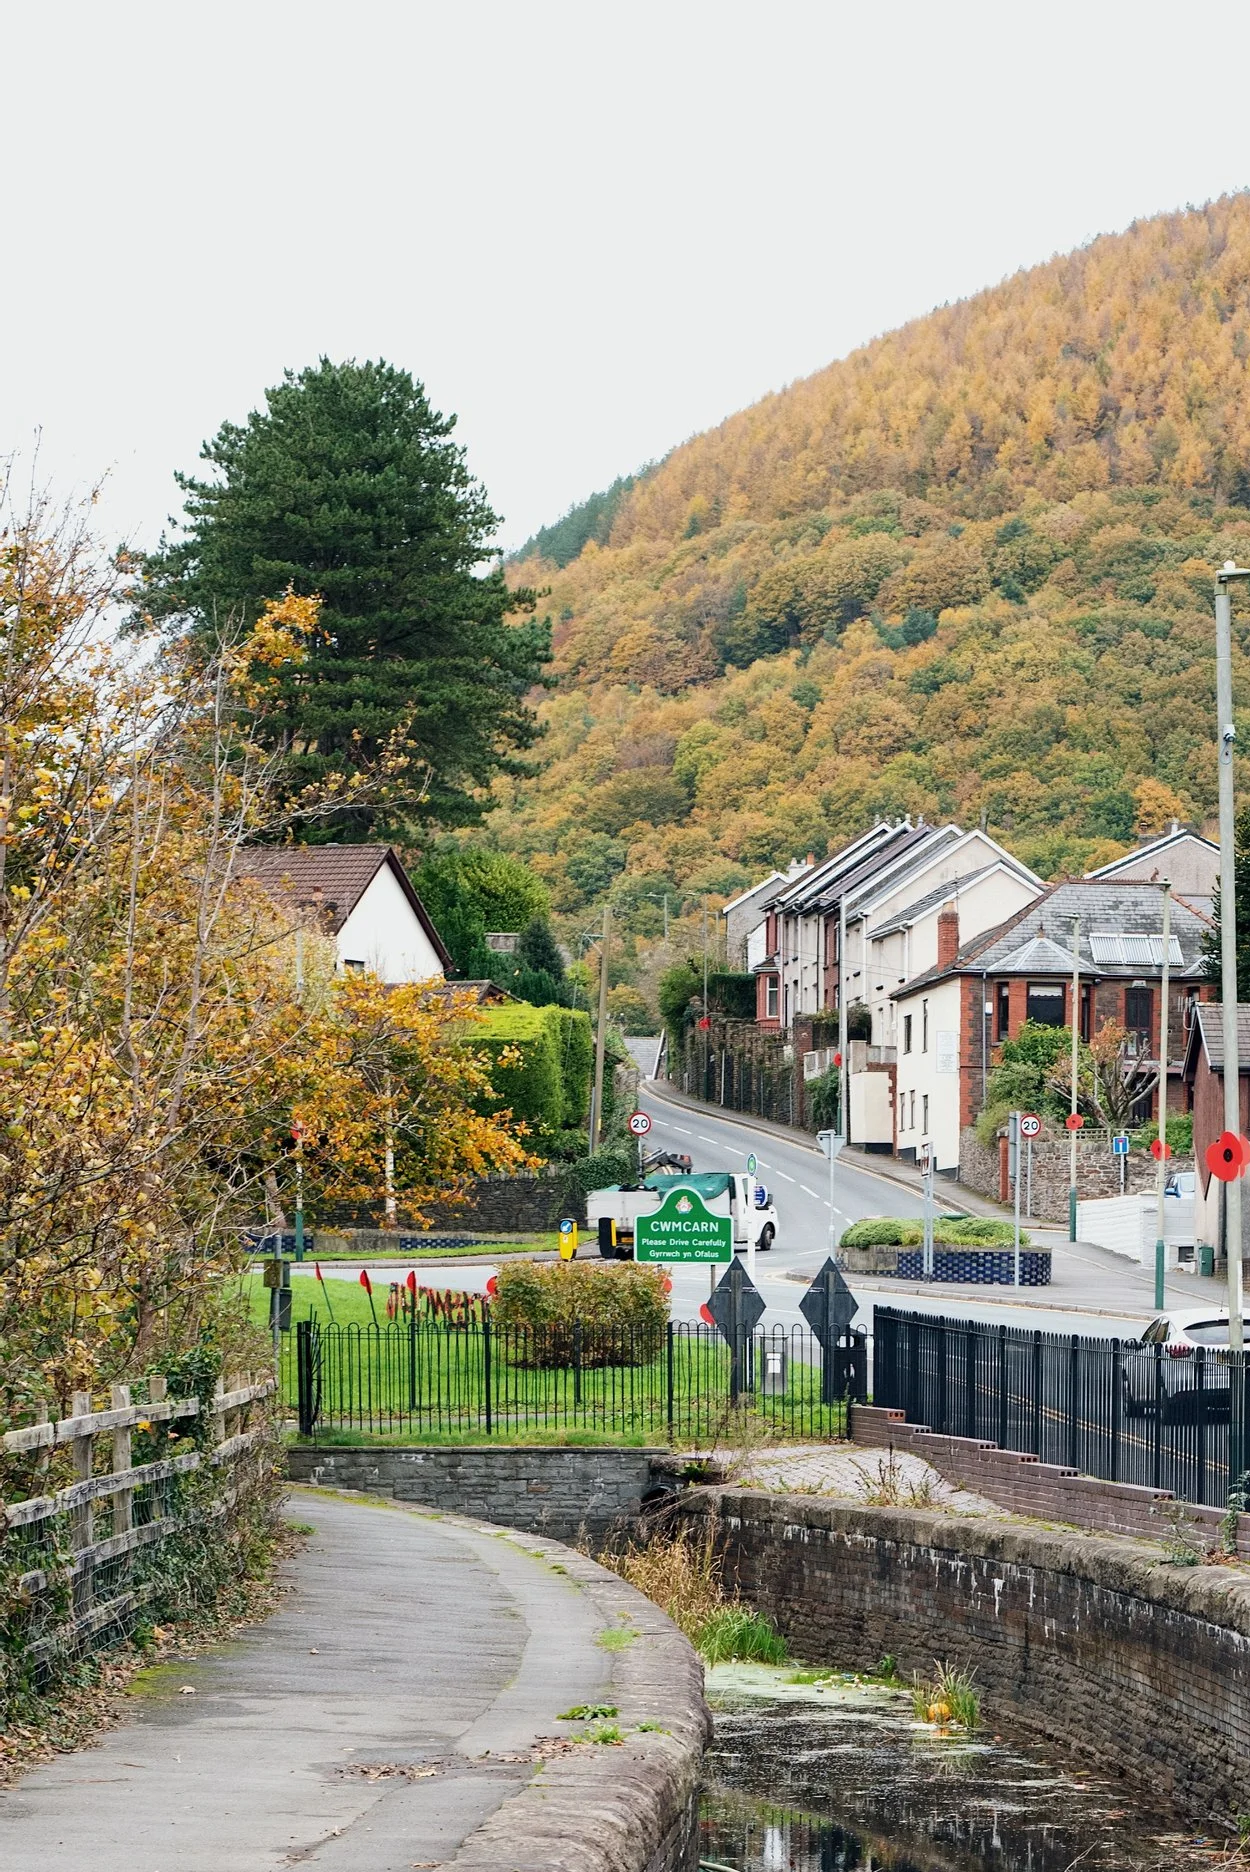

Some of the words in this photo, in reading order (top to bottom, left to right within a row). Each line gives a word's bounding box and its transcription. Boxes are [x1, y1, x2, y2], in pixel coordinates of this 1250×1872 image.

[633, 1119, 648, 1128] 20
[1023, 1121, 1038, 1130] 20
[650, 1221, 719, 1232] CWMCARN
[642, 1238, 667, 1246] Please
[692, 1239, 727, 1248] Carefully
[649, 1250, 680, 1258] Gyrrwch
[694, 1250, 719, 1258] Ofalus
